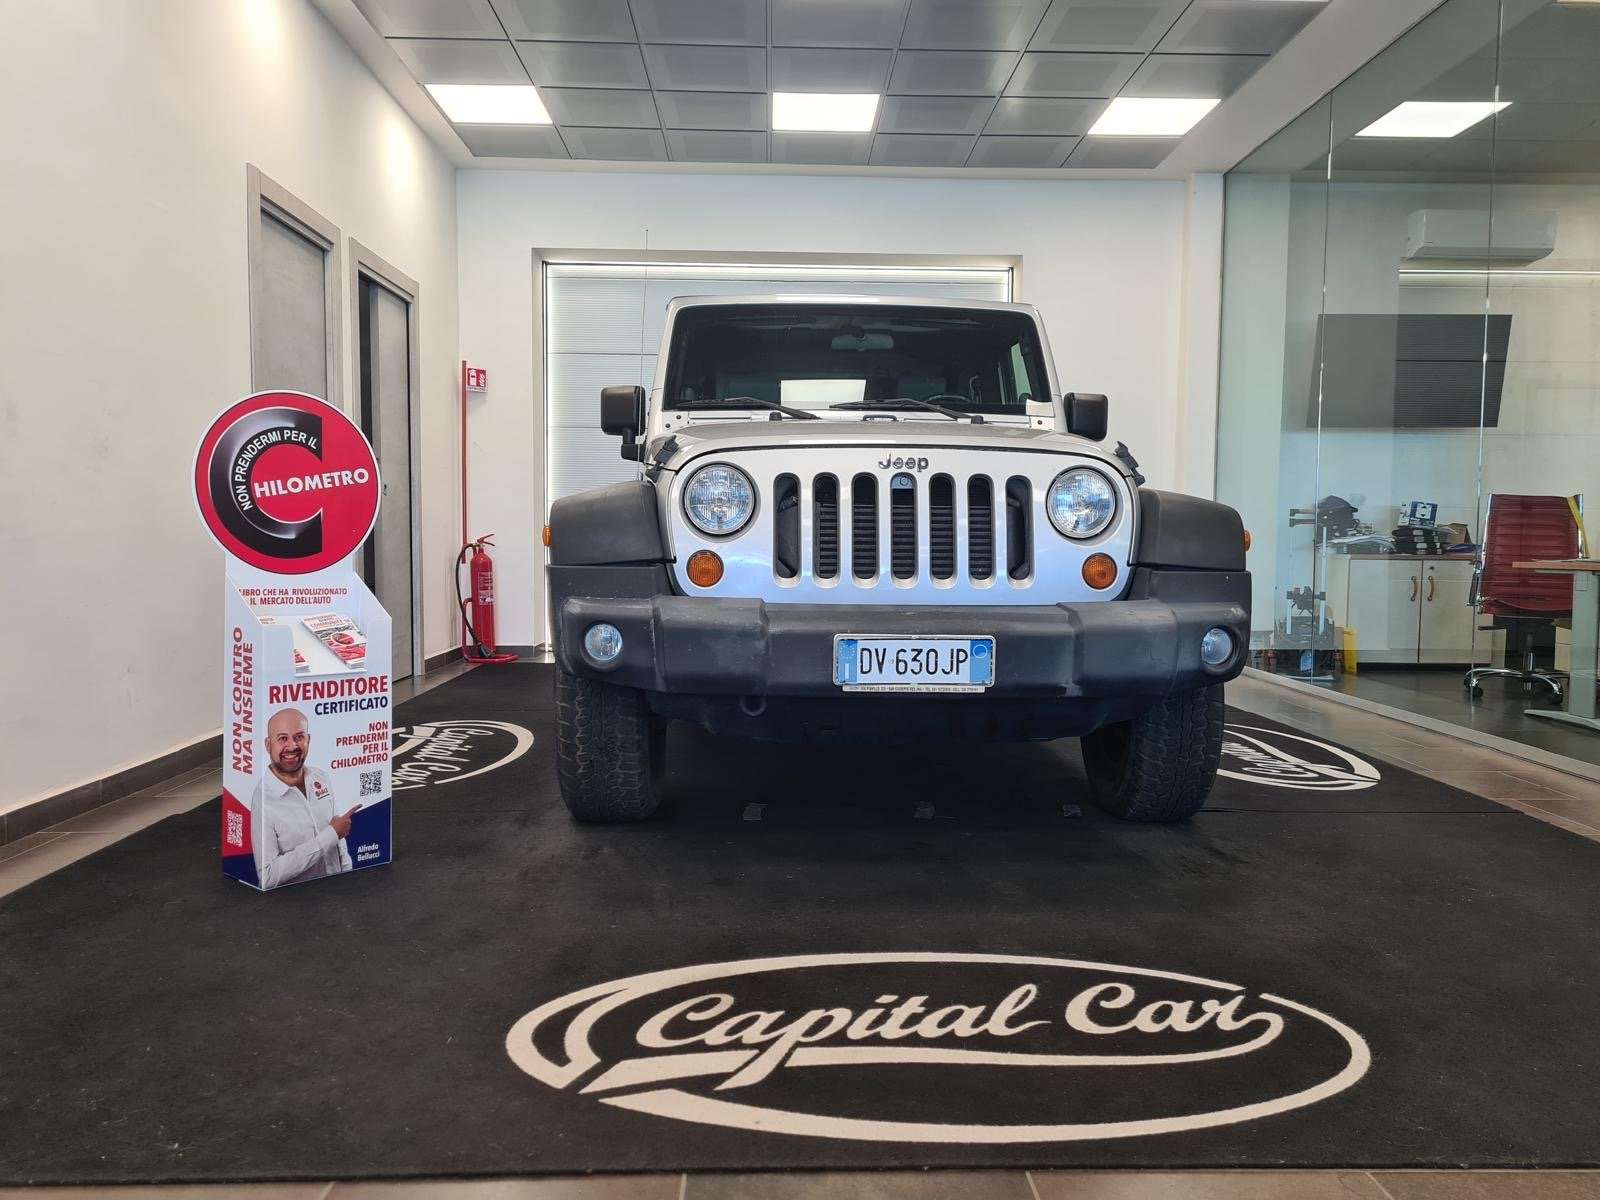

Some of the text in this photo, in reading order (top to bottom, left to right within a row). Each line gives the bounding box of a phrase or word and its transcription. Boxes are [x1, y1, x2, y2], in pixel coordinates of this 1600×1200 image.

[235, 429, 318, 511] NON PRENDERMI PER IL
[878, 453, 929, 473] Jeep
[250, 596, 332, 606] IL MERCATO DELL'AUTO
[262, 588, 277, 596] CHE
[278, 588, 289, 596] HA
[292, 587, 348, 596] RIVOLUZIONATO
[859, 647, 887, 675] DV
[233, 627, 242, 772] NON CONTRO
[269, 675, 388, 704] RIVENDITORE
[242, 643, 253, 775] MA INSIEME
[314, 696, 388, 716] CERTIFICATO
[369, 721, 388, 732] NON
[336, 732, 388, 747] PRENDERMI
[363, 742, 388, 754] PER IL
[331, 752, 388, 770] CHILOMETRO
[357, 842, 379, 853] Alfredo
[637, 982, 1264, 1090] Capital Car
